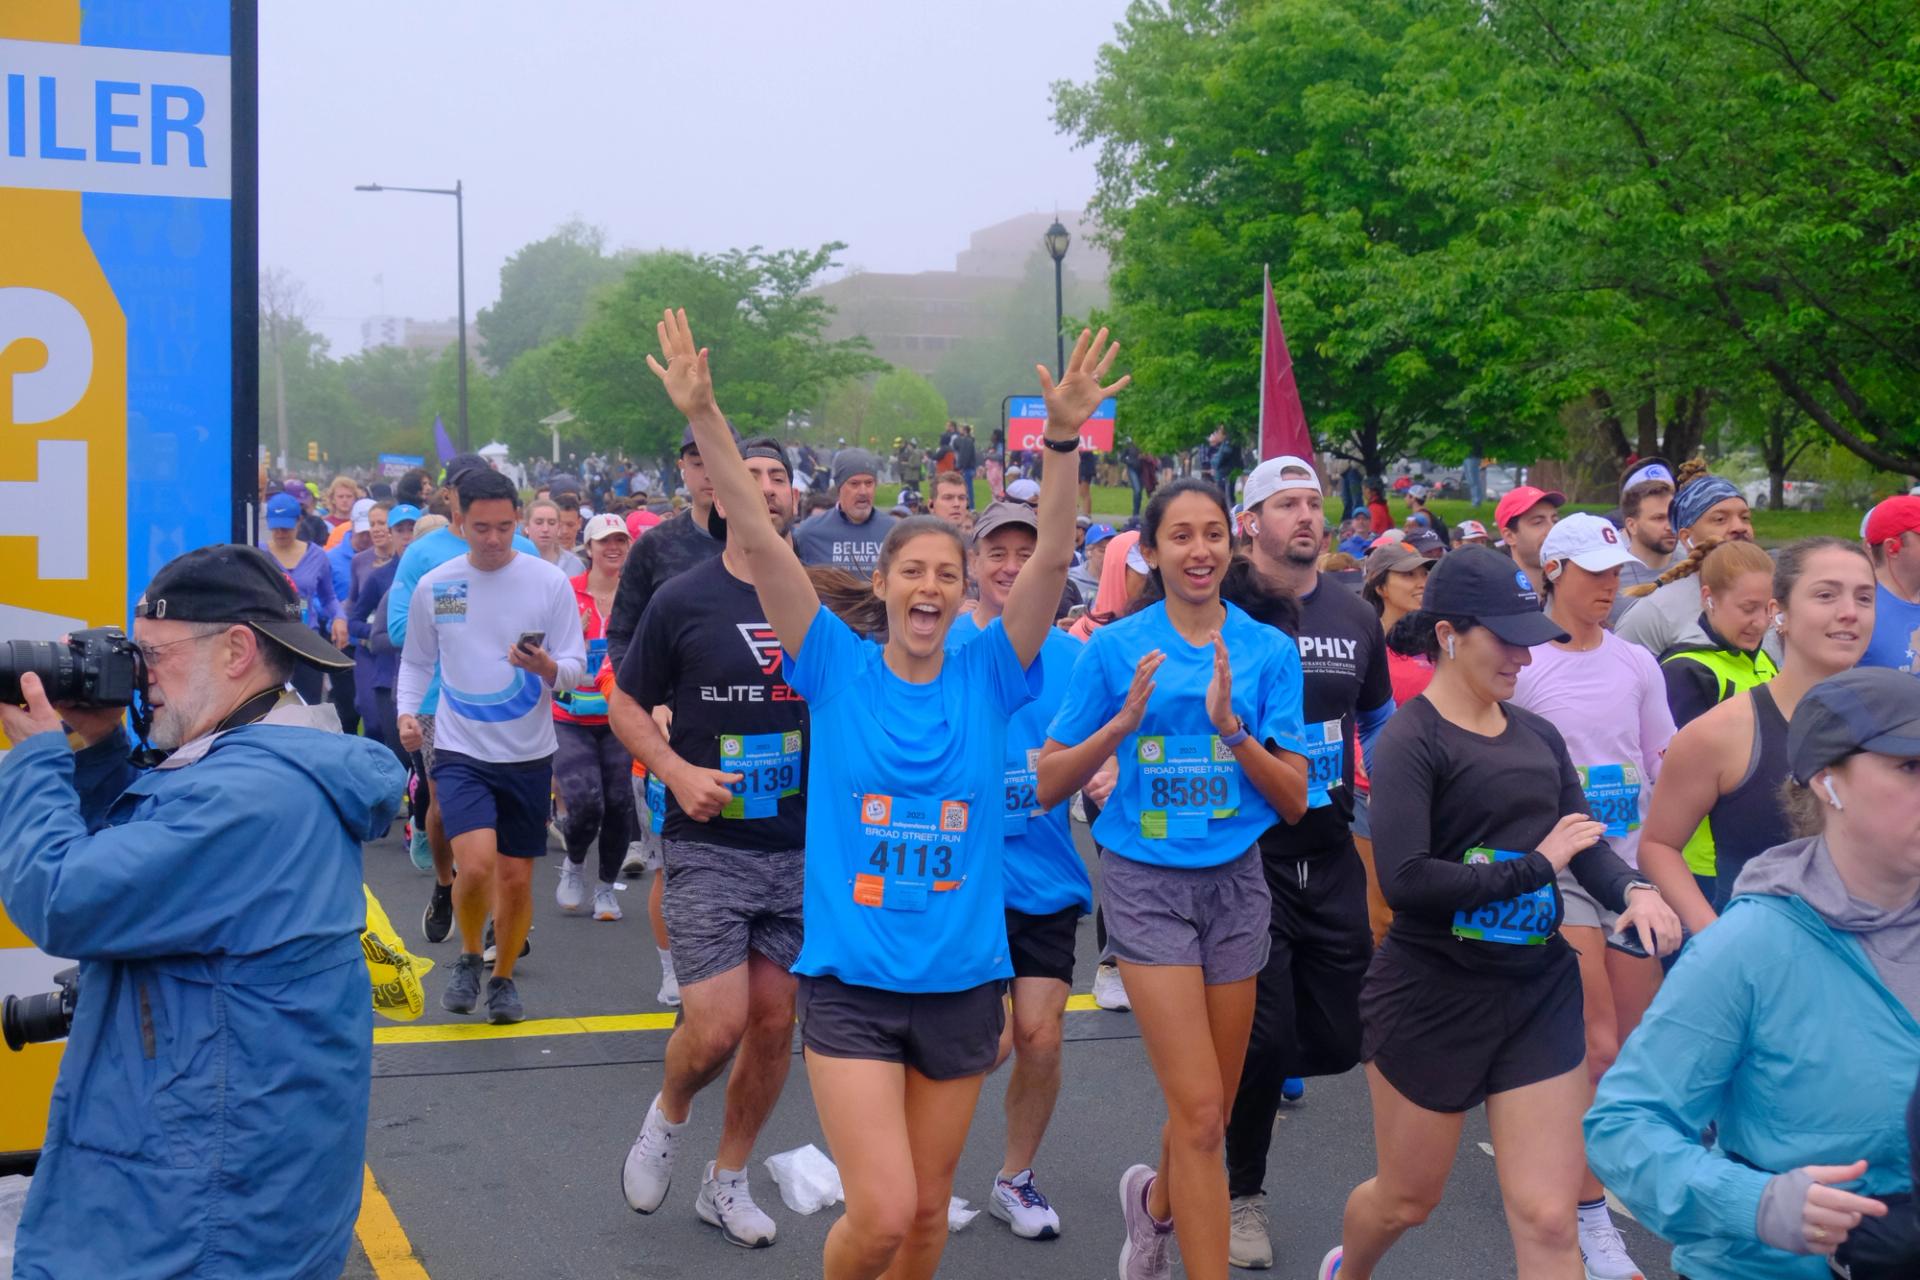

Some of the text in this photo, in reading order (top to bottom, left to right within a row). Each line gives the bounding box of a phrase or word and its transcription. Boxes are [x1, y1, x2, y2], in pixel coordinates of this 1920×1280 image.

[8, 73, 208, 168] ILER
[1022, 434, 1098, 450] COAL
[1602, 527, 1618, 544] G
[833, 541, 884, 554] BELIEV
[1298, 636, 1357, 660] PHLY
[700, 686, 764, 701] ELITE
[754, 758, 782, 766] STREET
[1178, 766, 1211, 774] STREET
[1214, 765, 1233, 773] RUN
[731, 765, 793, 794] 8139
[1152, 776, 1228, 808] 8589
[906, 811, 925, 819] 2023
[865, 827, 960, 843] BROAD STREET RUN
[869, 840, 952, 878] 4113
